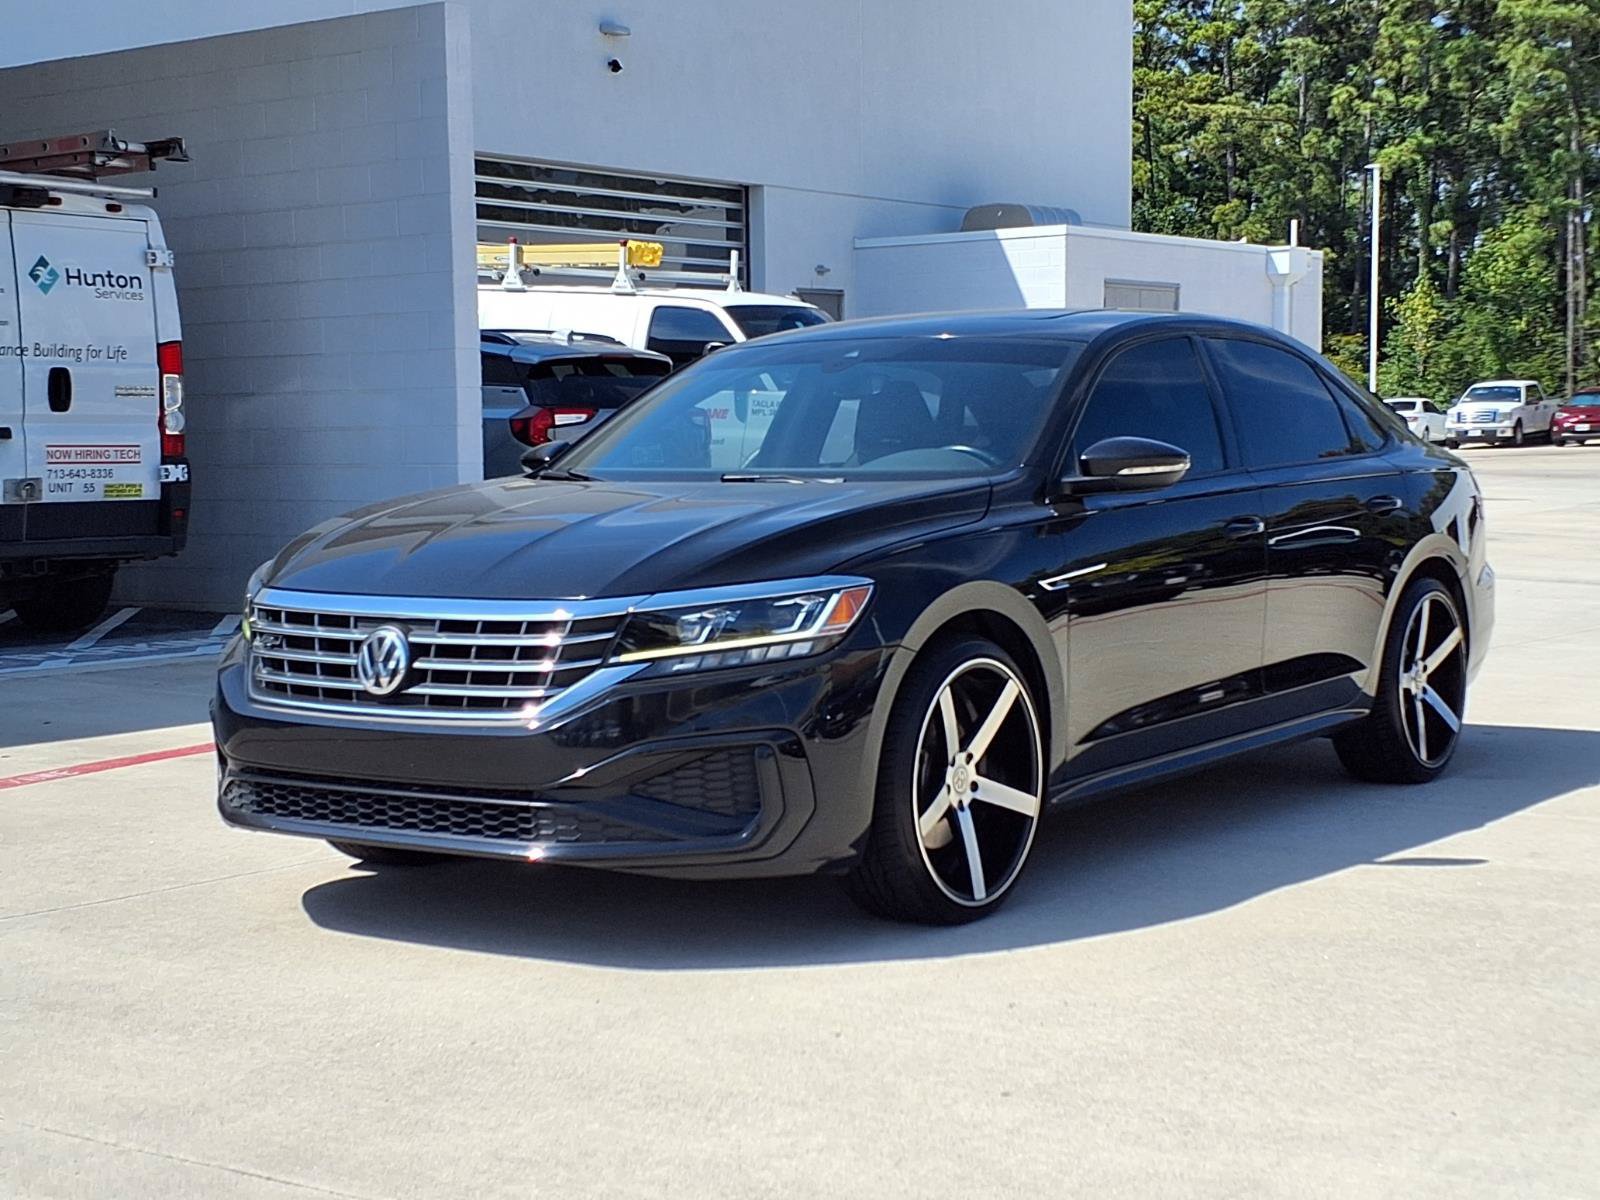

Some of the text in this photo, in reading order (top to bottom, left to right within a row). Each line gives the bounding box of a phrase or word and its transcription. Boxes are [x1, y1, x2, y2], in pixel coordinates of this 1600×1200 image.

[65, 268, 142, 289] Hunton
[95, 288, 144, 300] Services
[33, 343, 82, 362] Building
[86, 344, 103, 361] for
[107, 345, 128, 363] Life
[46, 450, 141, 459] NOW HIRING TECH
[48, 483, 74, 493] UNIT
[83, 483, 95, 493] 55
